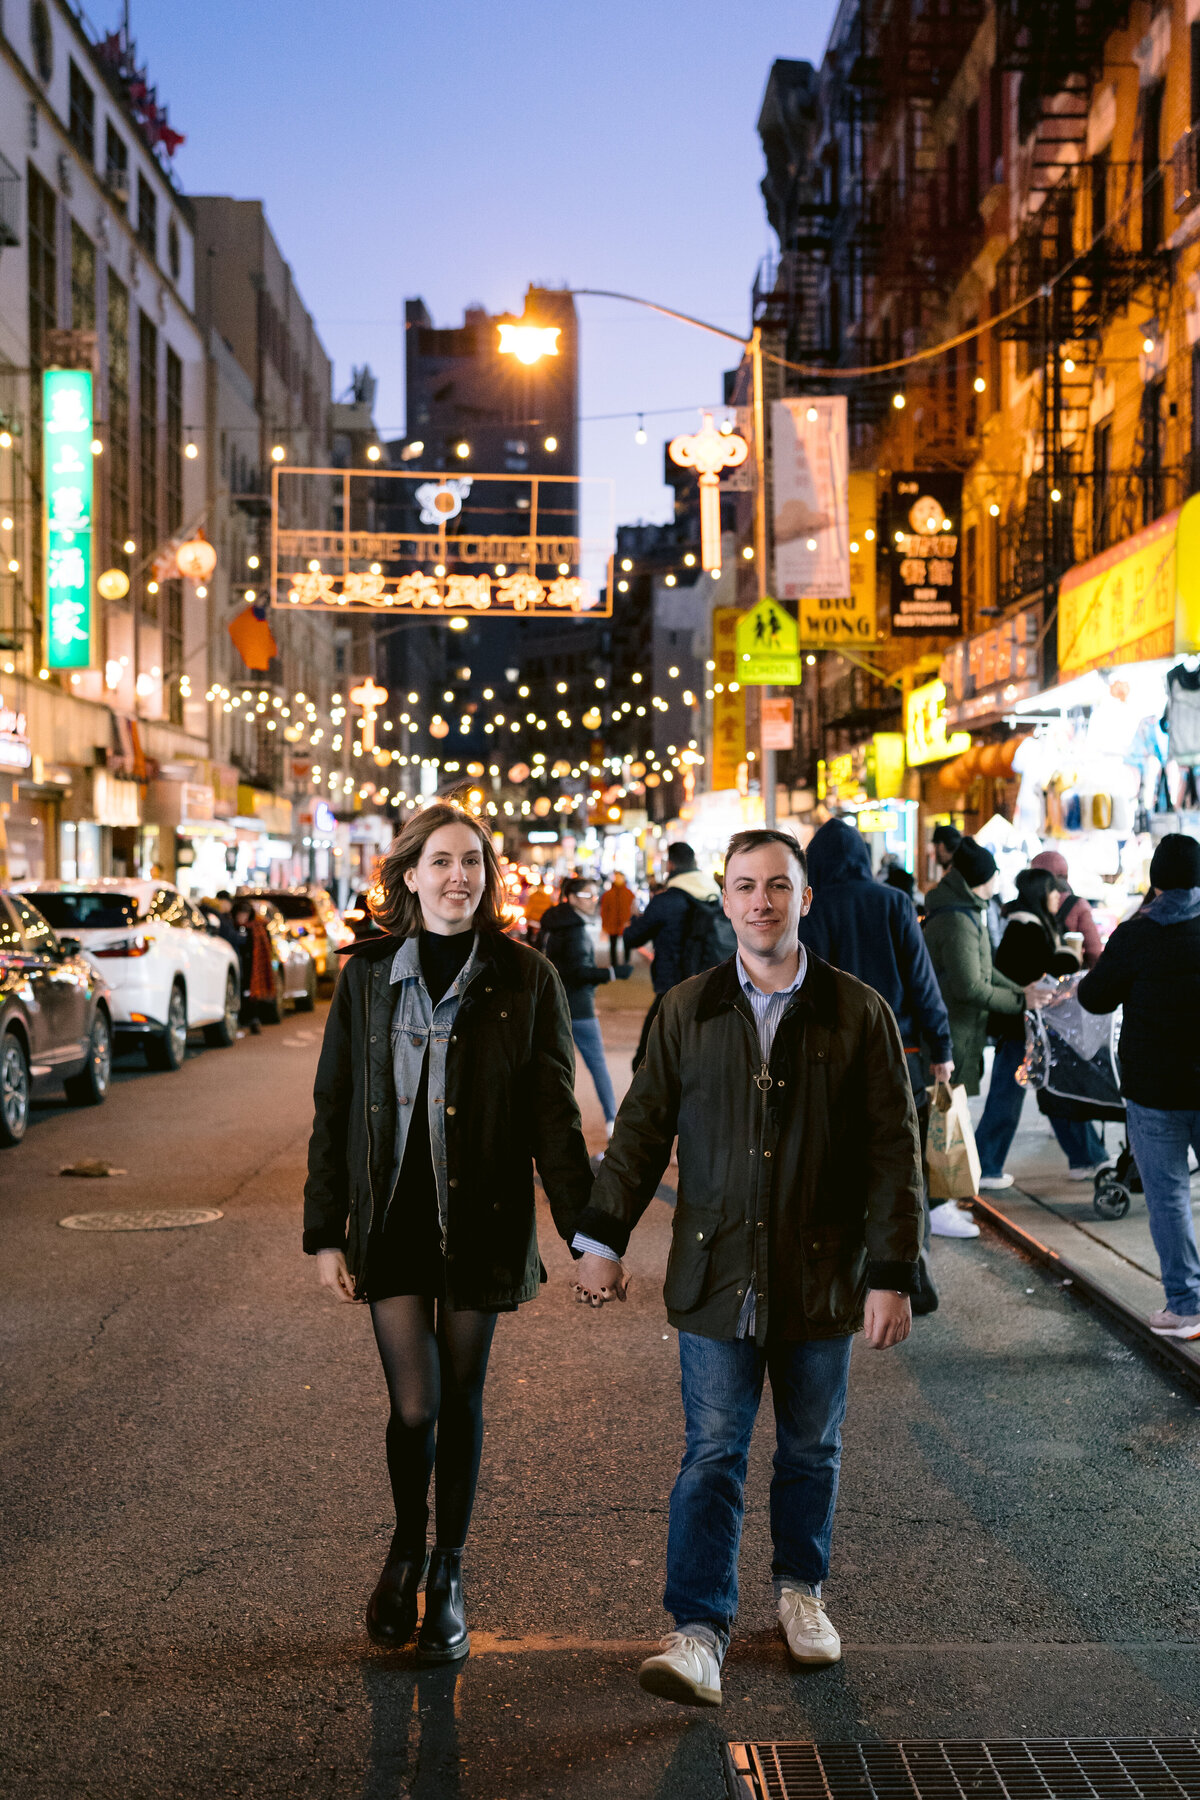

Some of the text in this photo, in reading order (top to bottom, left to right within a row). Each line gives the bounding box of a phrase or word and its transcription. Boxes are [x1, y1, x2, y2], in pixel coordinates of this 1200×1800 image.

[278, 537, 400, 562] WELCOME
[415, 539, 446, 562] TO
[806, 616, 870, 636] WONG
[743, 663, 791, 676] SCHOOL
